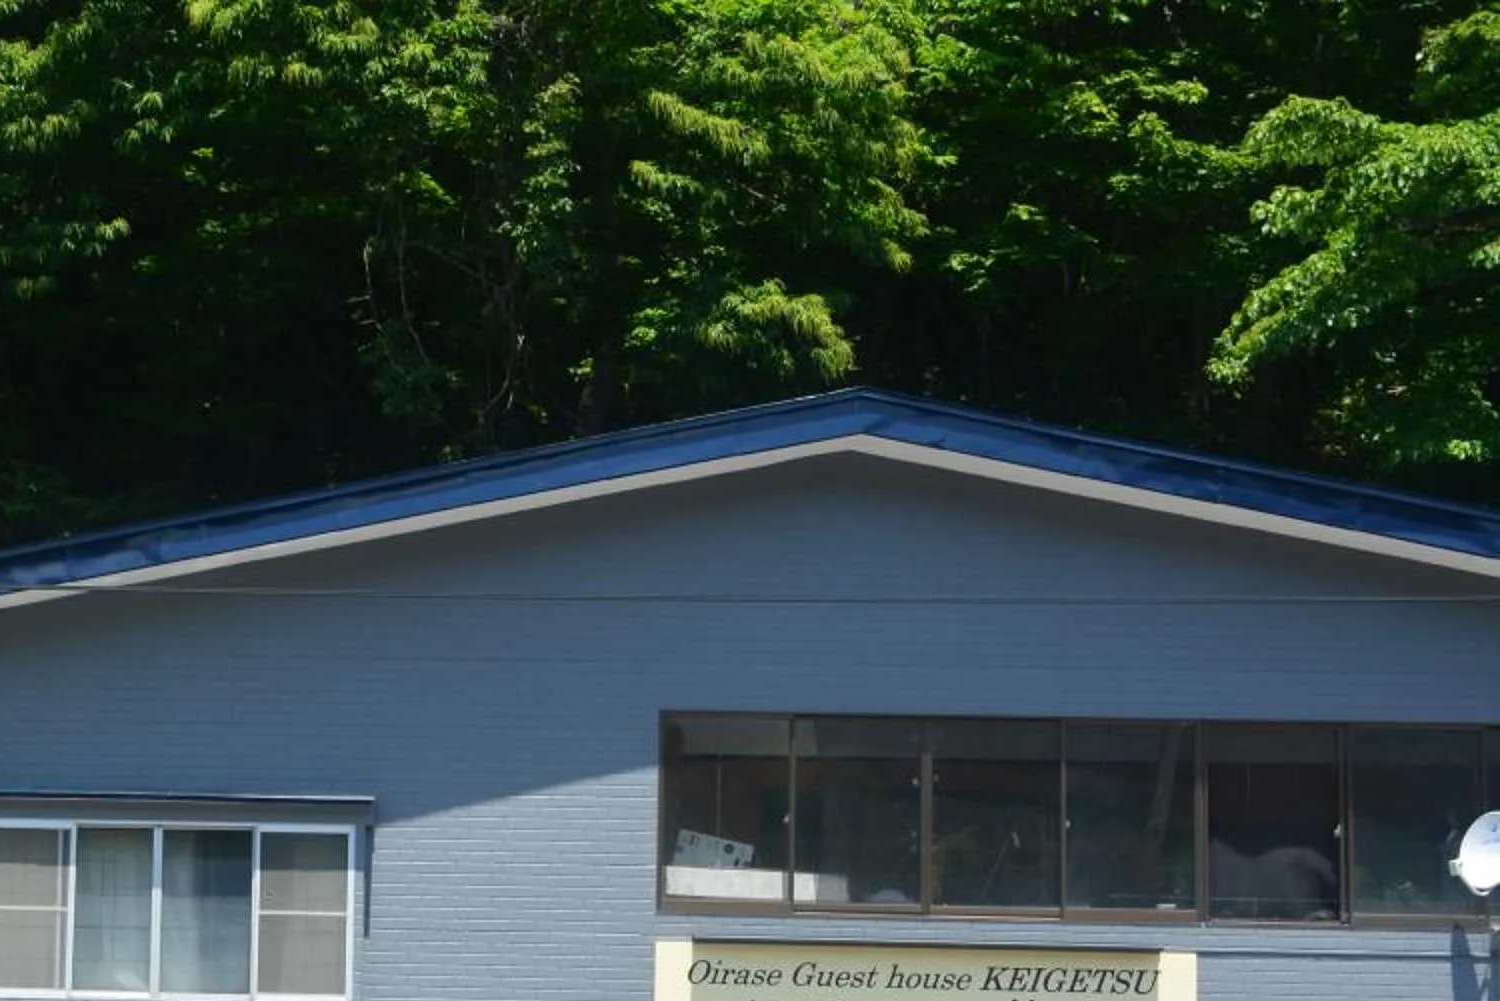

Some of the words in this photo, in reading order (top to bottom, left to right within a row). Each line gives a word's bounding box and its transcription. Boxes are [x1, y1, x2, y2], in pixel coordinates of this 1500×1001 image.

[687, 959, 782, 986] Oirase
[791, 961, 880, 989] Guest
[886, 963, 972, 991] house
[980, 966, 1161, 995] KEIGETSU
